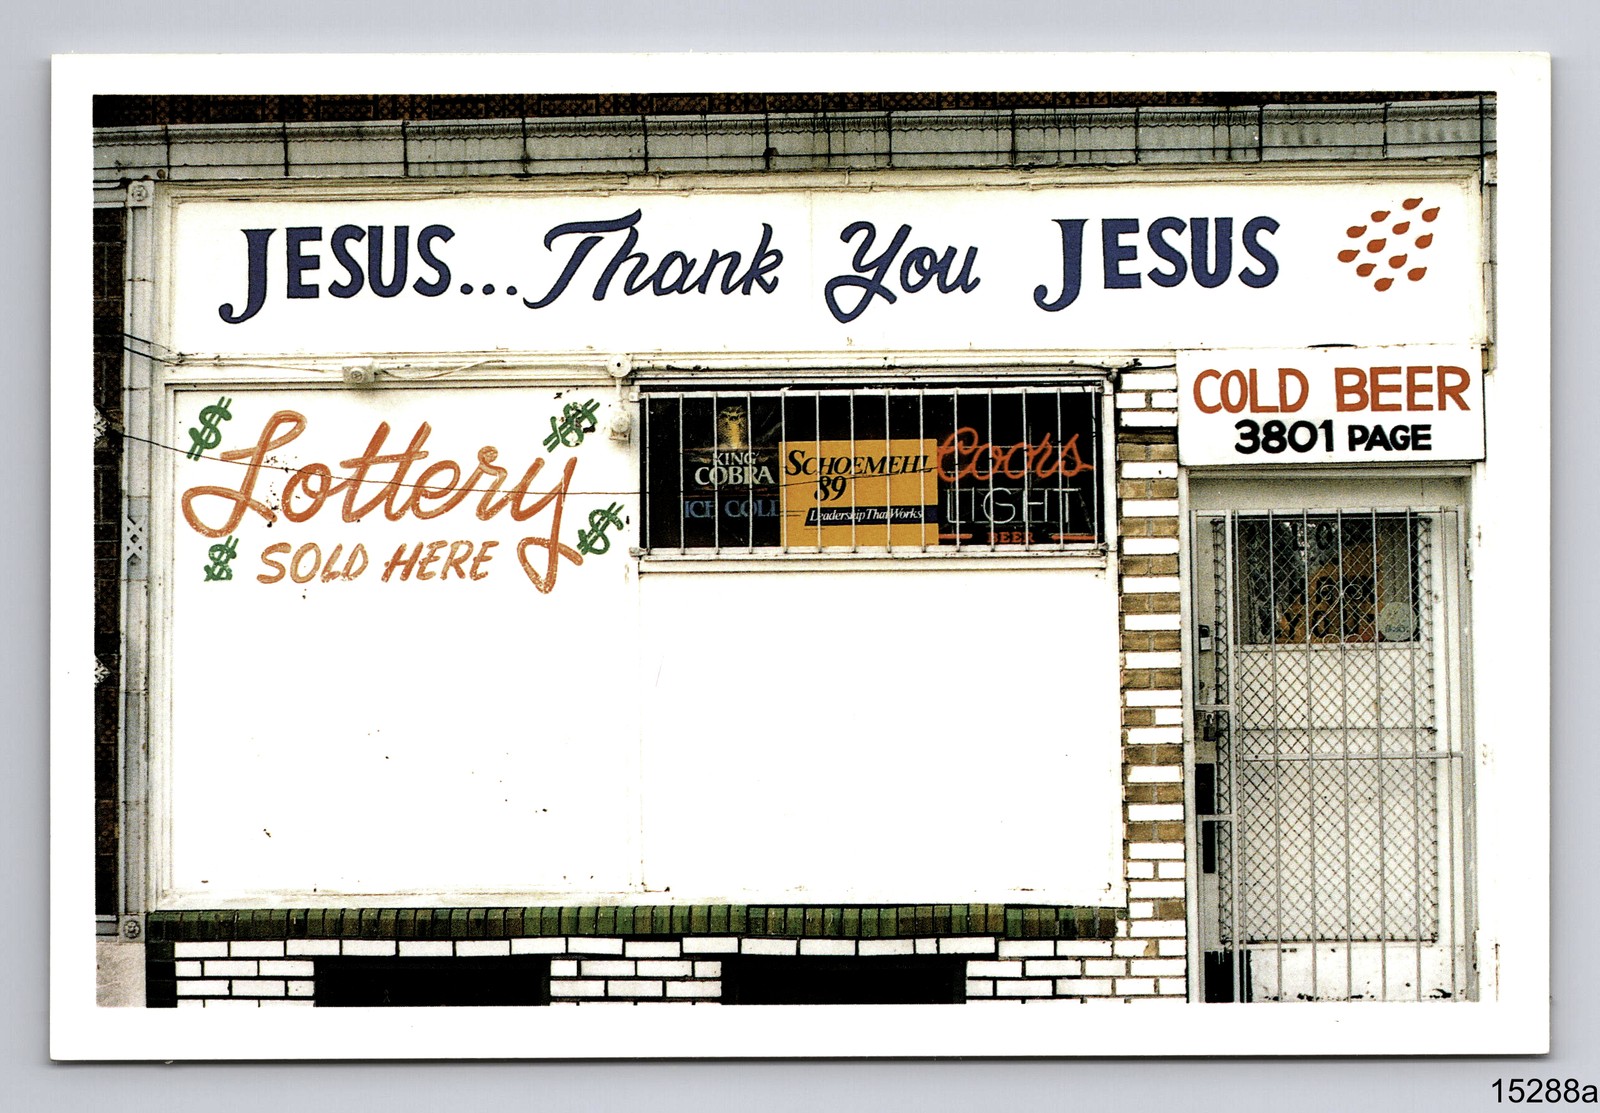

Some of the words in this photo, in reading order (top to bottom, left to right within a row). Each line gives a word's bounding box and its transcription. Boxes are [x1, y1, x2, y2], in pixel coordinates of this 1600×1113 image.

[522, 208, 784, 310] Thank
[824, 220, 981, 325] You
[1033, 215, 1281, 313] JESUS
[1192, 368, 1310, 415] COLD
[1334, 365, 1471, 413] BEER
[937, 426, 1095, 483] Coors
[1234, 418, 1335, 455] 3801
[1347, 423, 1432, 452] PAGE
[694, 465, 776, 486] COBRA
[712, 451, 757, 466] KING
[181, 409, 584, 595] Lottery
[813, 475, 847, 502] 89
[947, 487, 1079, 524] LIGHT
[987, 531, 1036, 544] BEER
[256, 541, 369, 585] SOLD
[381, 540, 499, 583] HERE
